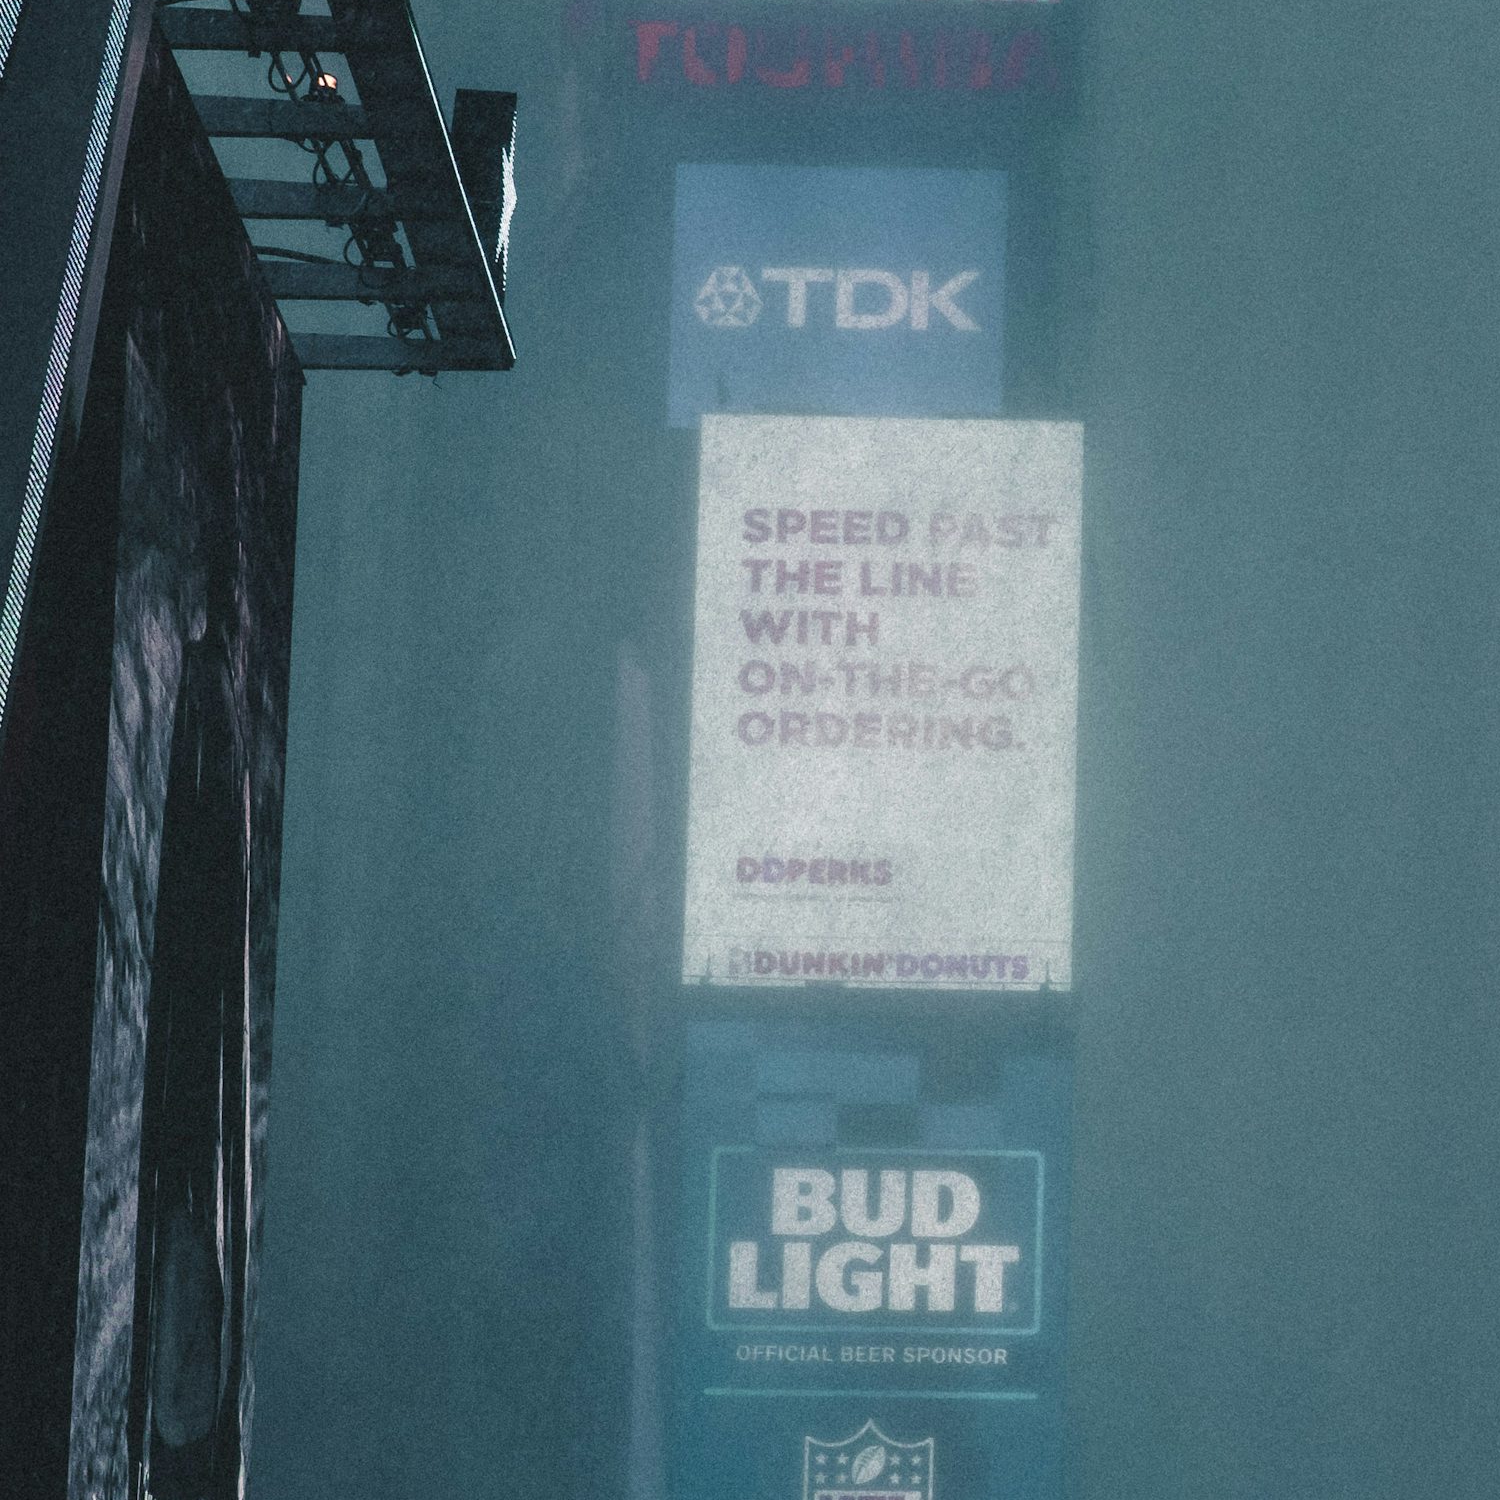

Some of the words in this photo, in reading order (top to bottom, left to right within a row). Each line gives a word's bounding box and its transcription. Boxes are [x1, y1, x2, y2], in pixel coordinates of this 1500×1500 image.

[762, 267, 981, 332] TDK
[742, 508, 909, 545] SPEED
[930, 514, 1054, 549] PAST
[742, 558, 841, 596] THE
[860, 561, 978, 598] LINE
[740, 610, 879, 647] WITH
[738, 660, 1034, 701] ON-THE-GO
[737, 711, 1026, 751] ORDERING.
[896, 954, 1031, 980] DONUTS
[772, 1168, 981, 1237] BUD
[728, 1241, 1019, 1313] LIGHT
[736, 1344, 833, 1363] OFFICIAL
[841, 1345, 894, 1363] BEER
[903, 1346, 1007, 1365] SPONSOR
